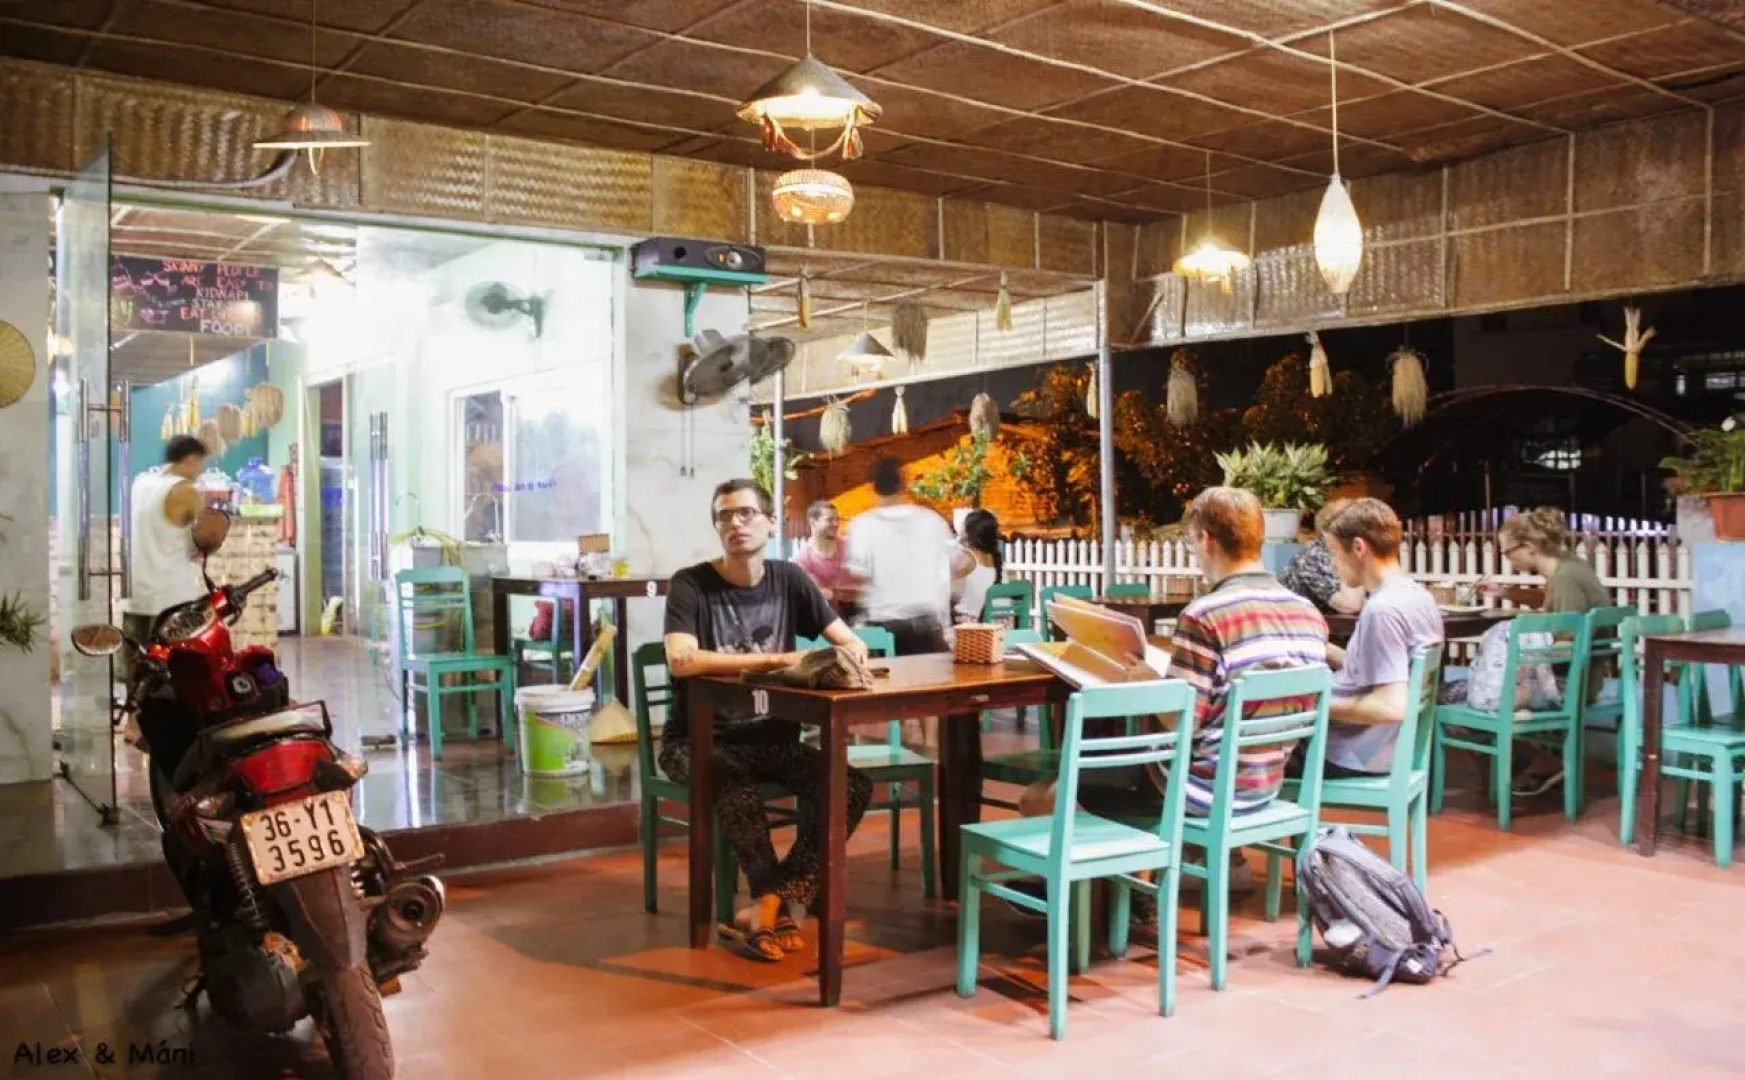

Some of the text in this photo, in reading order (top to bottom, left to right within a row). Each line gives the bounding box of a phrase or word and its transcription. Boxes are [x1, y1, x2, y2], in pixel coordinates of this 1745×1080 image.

[181, 275, 204, 286] ARE
[216, 276, 247, 288] EASY
[179, 307, 205, 320] EAT
[646, 580, 657, 597] 9
[751, 689, 769, 715] 10
[260, 799, 334, 841] 36-Y1
[268, 829, 345, 872] 3596
